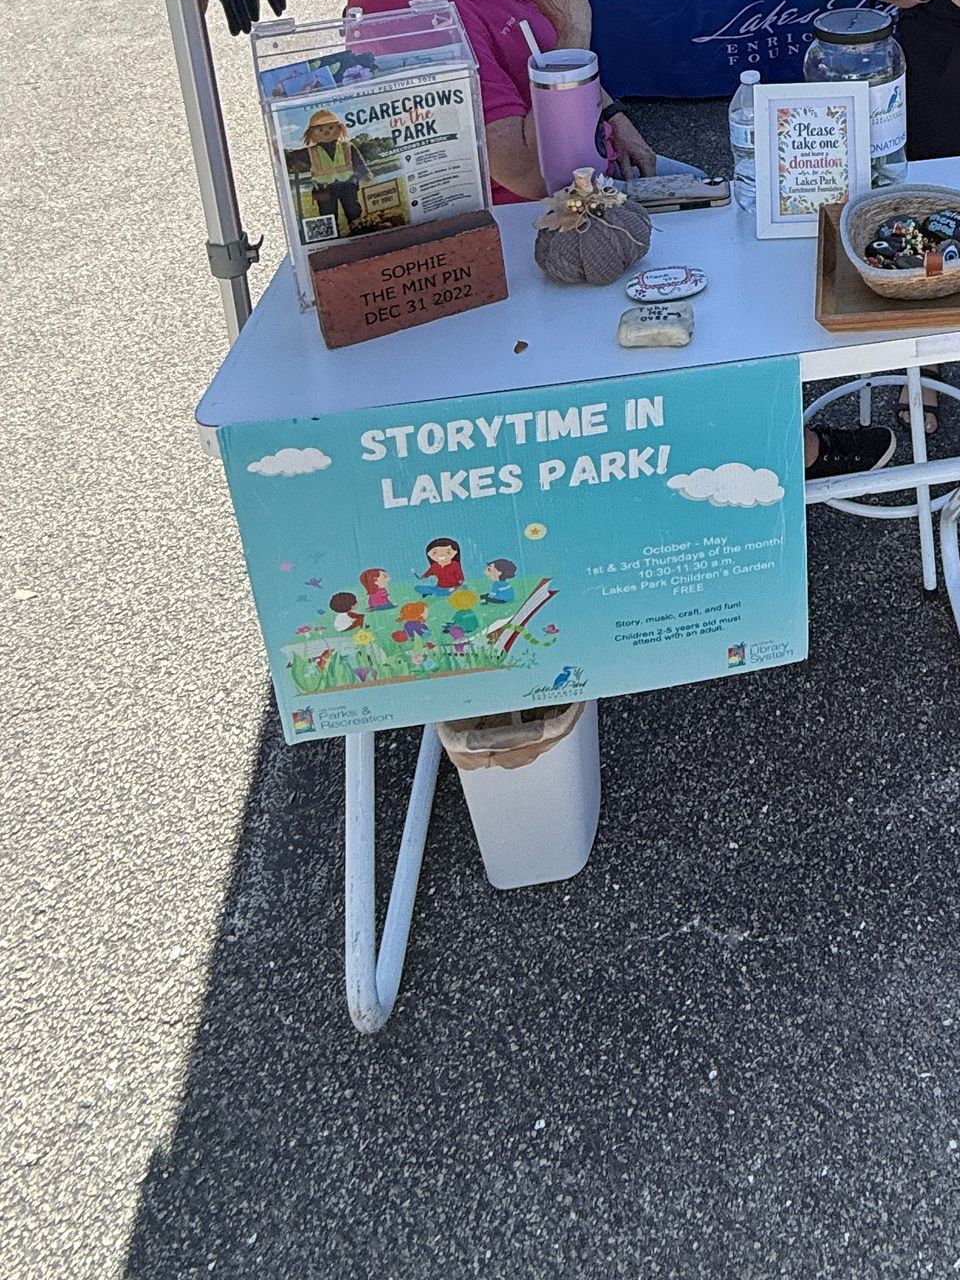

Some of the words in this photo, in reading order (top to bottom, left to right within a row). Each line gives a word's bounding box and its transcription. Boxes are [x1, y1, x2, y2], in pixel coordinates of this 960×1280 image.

[691, 0, 820, 43] Lakes
[726, 33, 813, 55] ENRIC
[378, 80, 415, 93] FESTIVAL
[344, 89, 464, 128] SCARECROWS
[409, 107, 433, 124] the
[391, 119, 438, 146] PARK
[793, 123, 835, 137] Please
[792, 137, 820, 150] take
[822, 139, 839, 150] one
[789, 156, 843, 170] donation
[795, 176, 818, 186] Lakes
[820, 176, 837, 185] Park
[381, 253, 447, 282] SOPHIE
[360, 286, 396, 307] THE
[402, 274, 437, 295] MIN
[442, 266, 472, 284] PIN
[364, 304, 402, 326] DEC
[406, 297, 427, 314] 31
[433, 284, 473, 306] 2022
[360, 402, 609, 461] STORYTIME
[625, 396, 664, 431] IN
[381, 463, 524, 509] LAKES
[539, 445, 671, 492] PARK!
[643, 540, 692, 556] October
[703, 536, 727, 547] May
[586, 565, 604, 576] 1st
[607, 563, 617, 573] &
[620, 560, 640, 571] 3rd
[643, 551, 706, 568] Thursdays
[709, 547, 721, 557] of
[723, 544, 741, 554] the
[711, 558, 736, 568] a.m.
[602, 583, 638, 596] Lakes
[640, 578, 667, 590] Park
[670, 569, 730, 585] Children's
[732, 560, 775, 575] Garden
[673, 583, 705, 596] FREE
[615, 617, 643, 629] Story,
[646, 613, 677, 624] music,
[678, 607, 702, 619] craft,
[705, 603, 722, 614] and
[724, 600, 742, 611] fun!
[614, 630, 654, 642] Children
[657, 627, 673, 636] 2-5
[675, 622, 700, 634] years
[702, 618, 717, 628] old
[719, 614, 741, 625] must
[632, 636, 662, 646] attend
[664, 631, 684, 642] with
[686, 630, 698, 638] an
[699, 624, 725, 636] adult.
[750, 641, 789, 656] Library
[750, 648, 794, 664] System
[318, 709, 356, 721] Parks
[360, 705, 372, 716] &
[320, 712, 394, 730] Recreation
